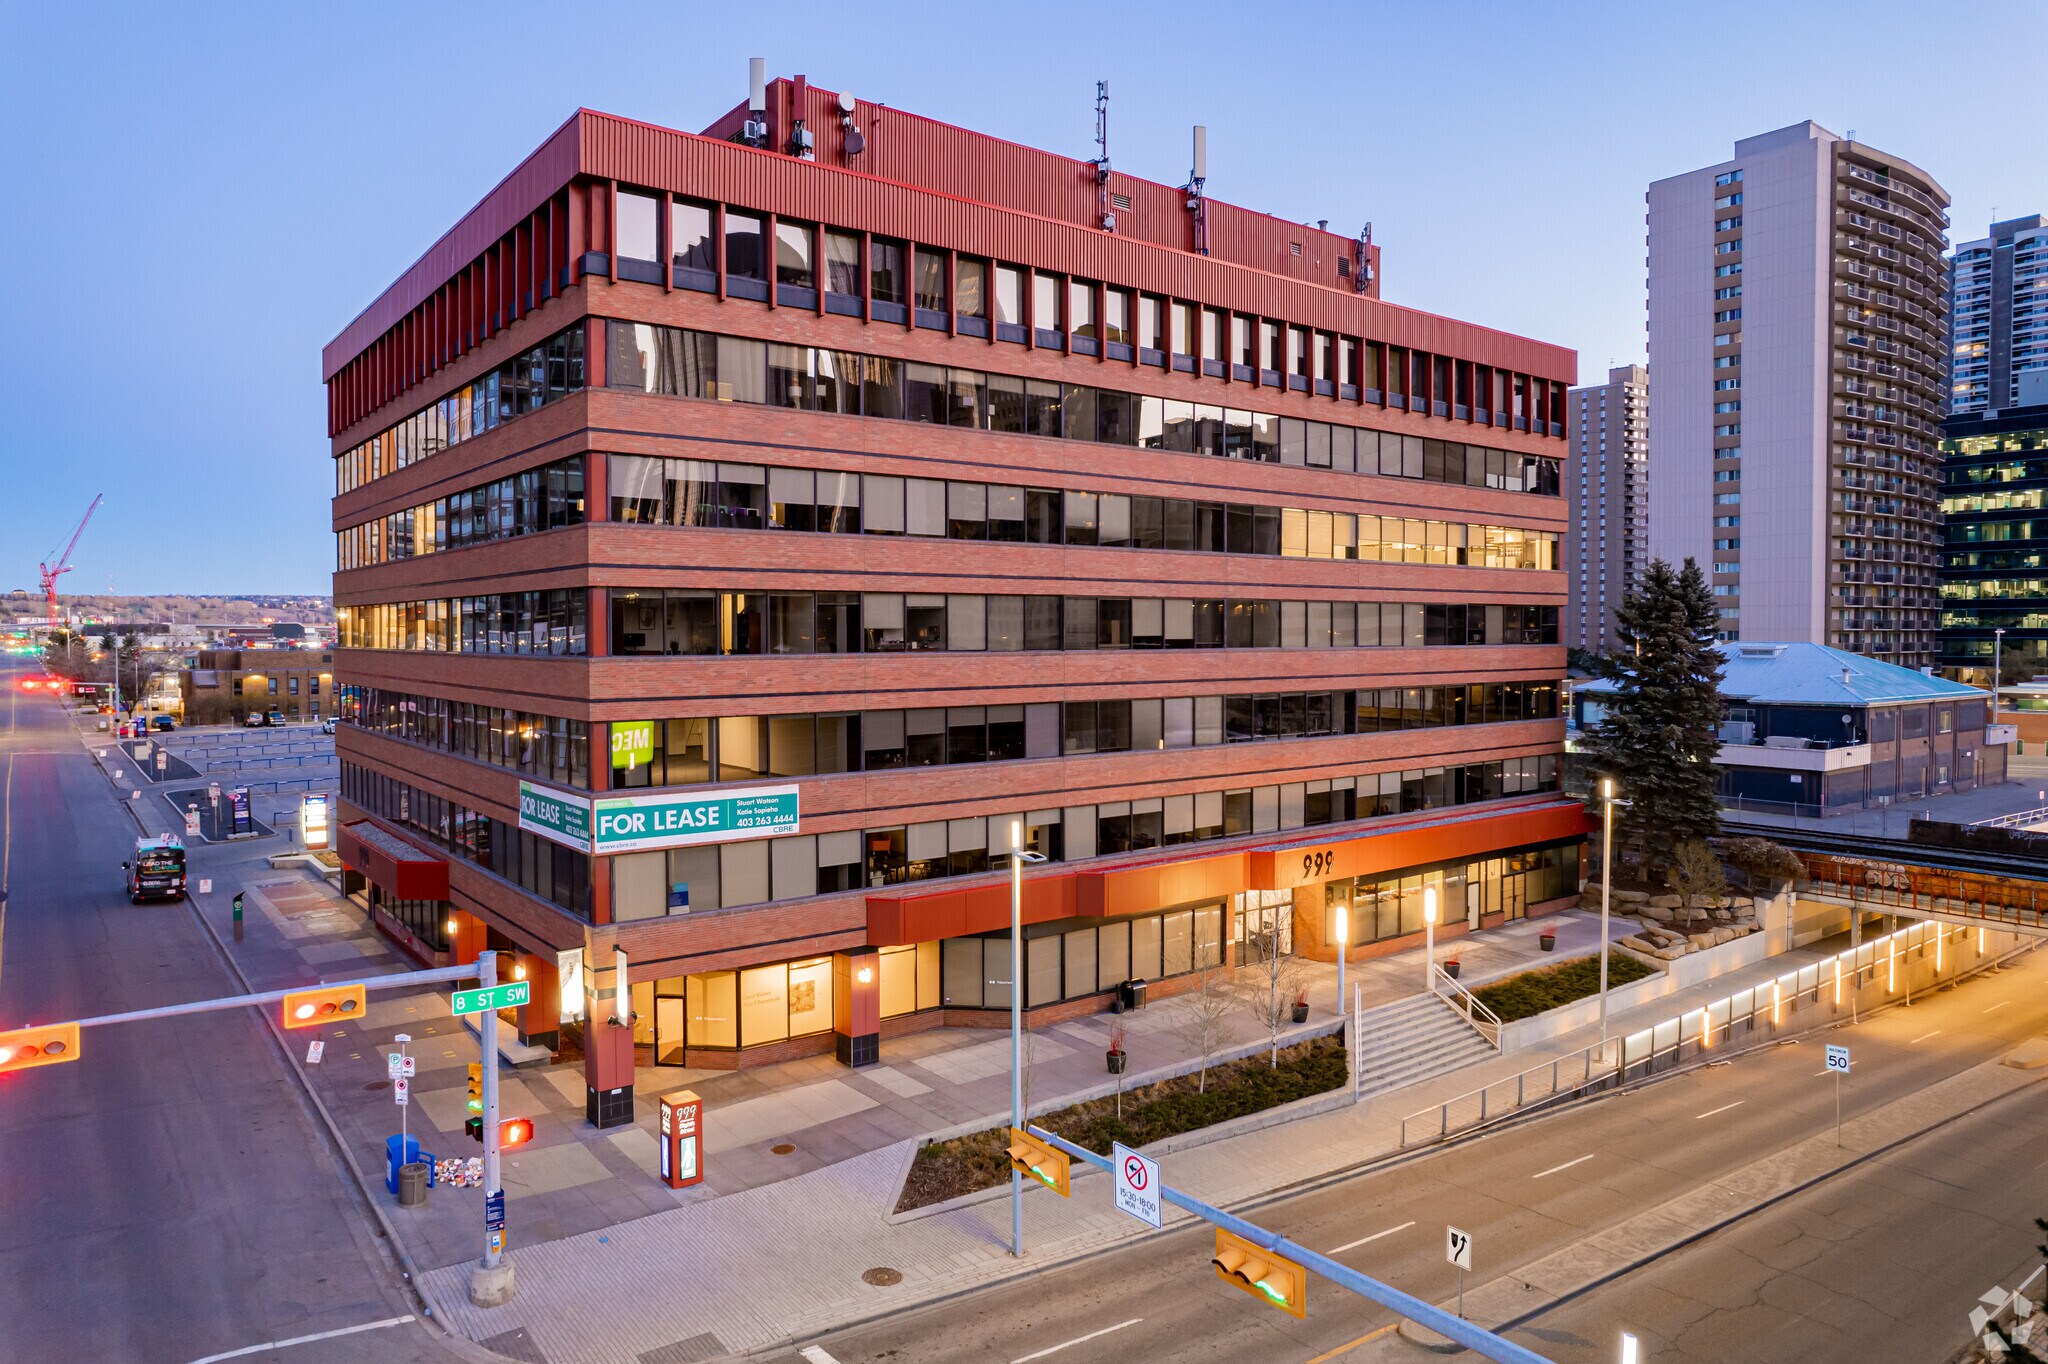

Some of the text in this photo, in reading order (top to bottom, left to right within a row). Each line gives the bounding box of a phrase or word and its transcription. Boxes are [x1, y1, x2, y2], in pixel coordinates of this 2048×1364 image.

[521, 795, 560, 825] FOR LEASE
[737, 799, 755, 807] Stuart
[600, 806, 719, 836] FOR LEASE
[737, 813, 794, 827] 403 263 4444
[773, 825, 793, 833] CBRE
[1303, 850, 1333, 879] 999
[456, 986, 526, 1010] 8 ST SW
[1828, 1055, 1847, 1068] 50
[676, 1104, 697, 1121] 999
[1120, 1187, 1156, 1213] 15:30-18:00
[1125, 1199, 1136, 1210] MON
[1141, 1208, 1150, 1217] FRI
